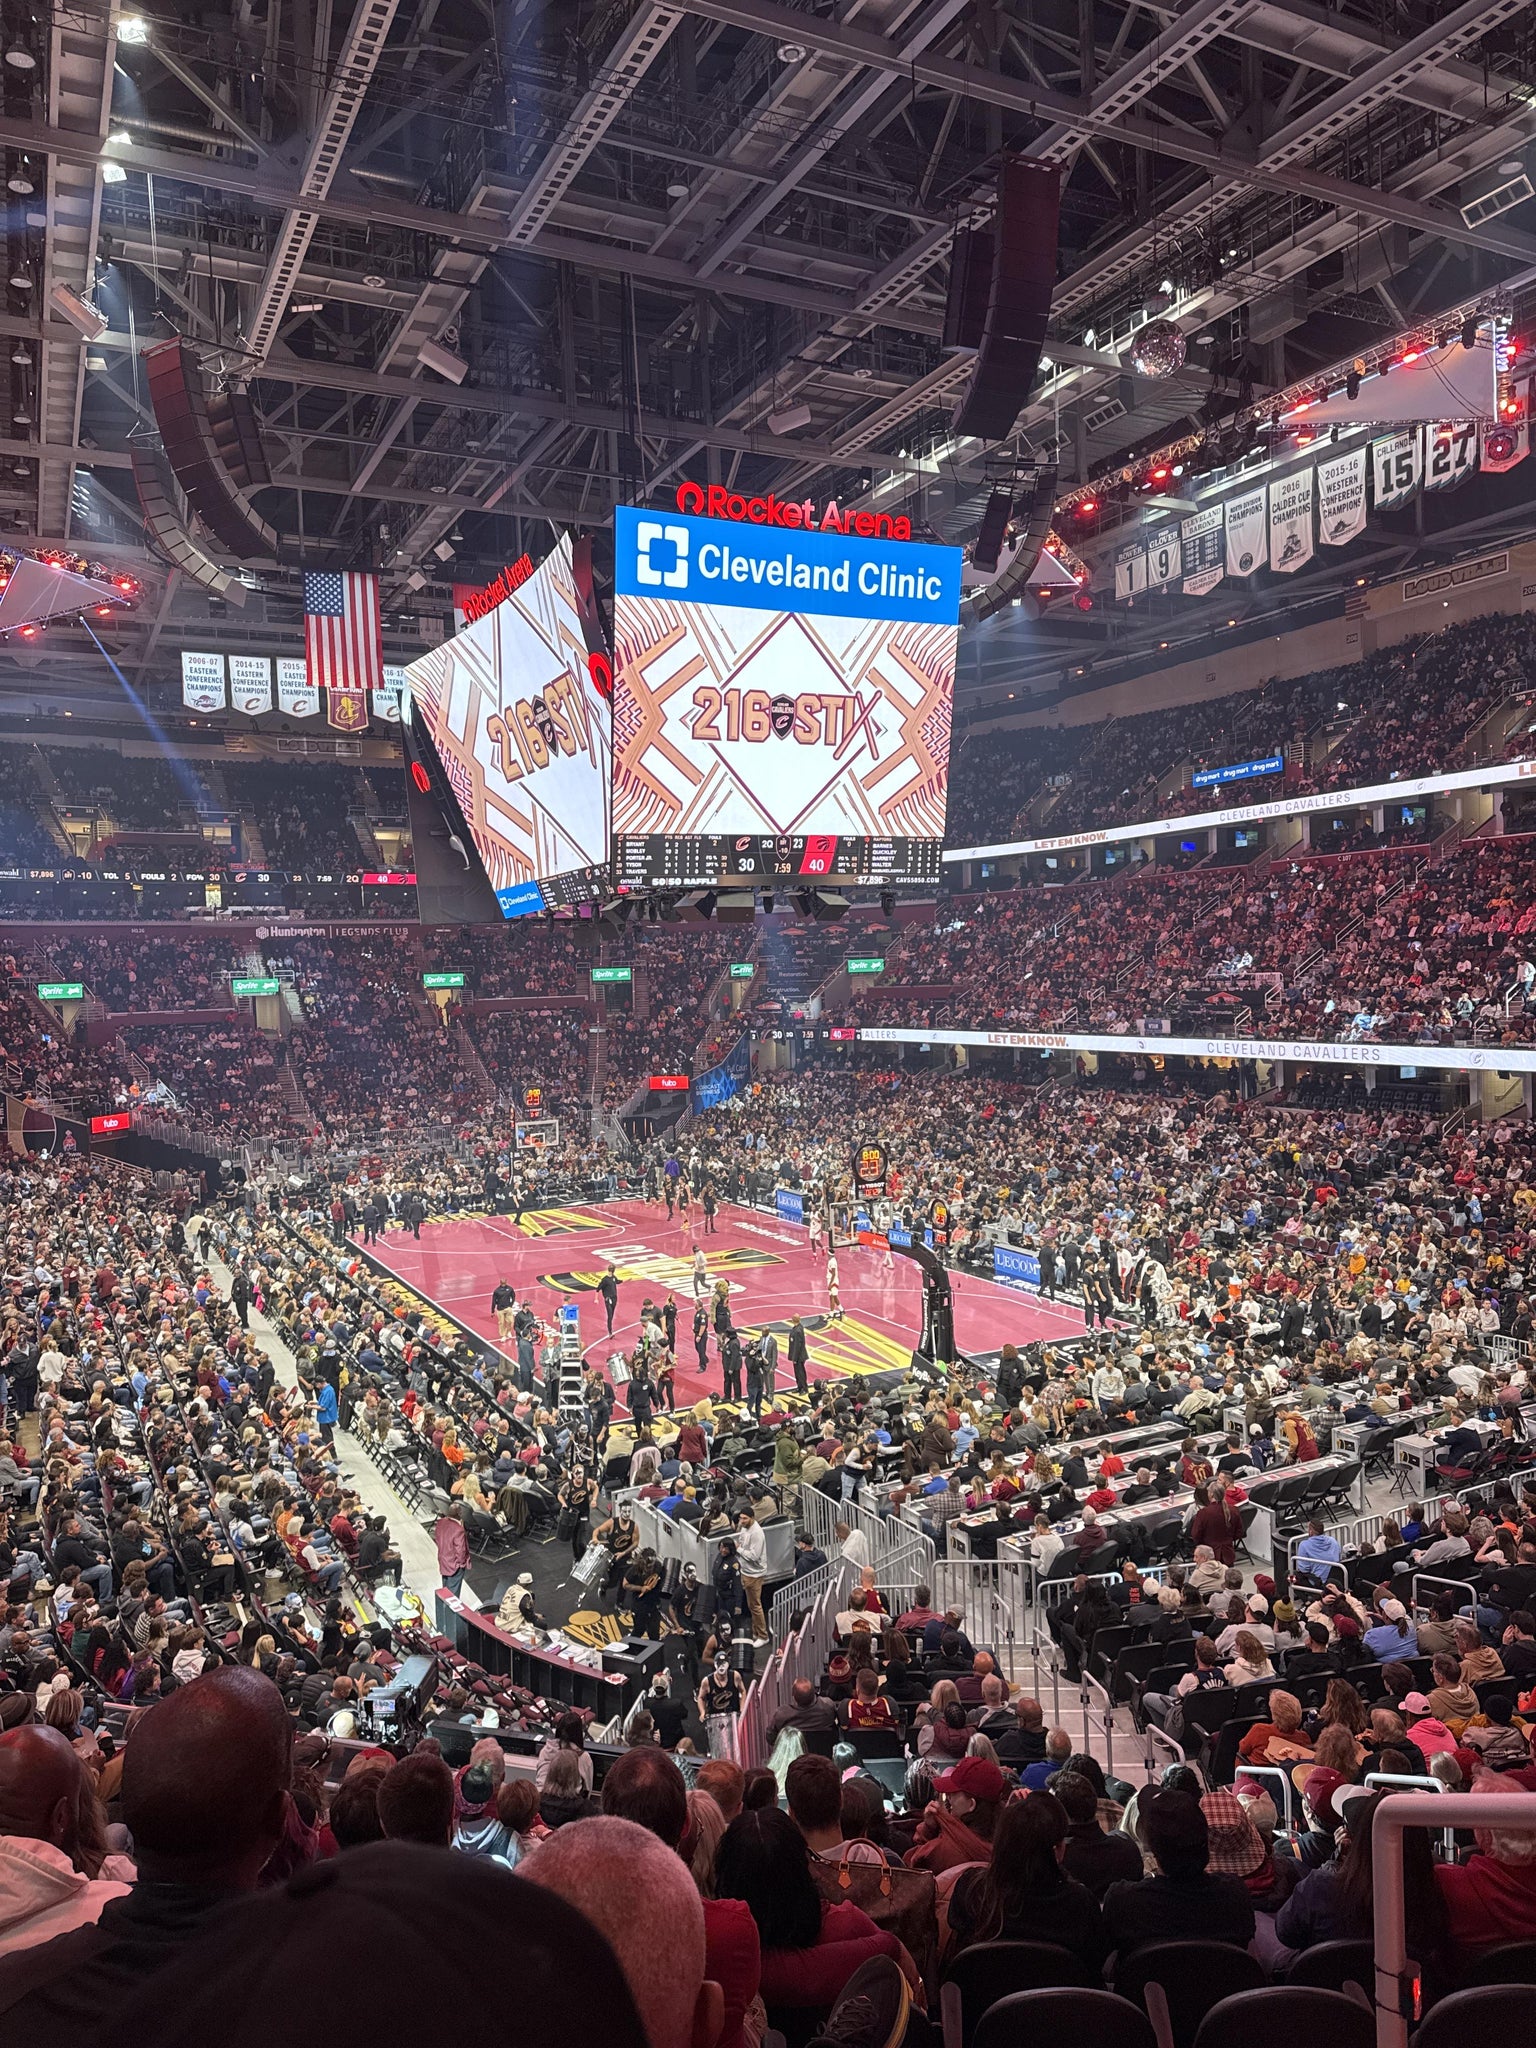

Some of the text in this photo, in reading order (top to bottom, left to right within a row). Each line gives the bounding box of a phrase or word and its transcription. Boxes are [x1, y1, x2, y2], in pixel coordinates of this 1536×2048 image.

[1433, 428, 1471, 477] 27
[1325, 461, 1359, 480] 2015-16
[1382, 450, 1414, 495] 15
[1282, 480, 1300, 495] 2016
[1326, 474, 1359, 493] WESTERN
[1272, 490, 1310, 513] CALDER CUP
[1321, 484, 1363, 507] CONFERENCE
[707, 484, 911, 540] Rocket Arena
[1228, 503, 1263, 523] CHAMPIONS
[1273, 503, 1311, 526] CHAMPIONS
[1323, 498, 1361, 519] CHAMPIONS
[1182, 508, 1222, 529] CLEVELAND
[1189, 518, 1216, 535] BARONS
[1149, 531, 1178, 549] GLOVER
[1118, 546, 1143, 561] BOWER
[1158, 549, 1169, 579] 9
[698, 543, 942, 601] Cleveland Clinic
[1127, 562, 1134, 592] 1
[473, 552, 534, 615] Rocket Arena
[188, 656, 218, 666] 2006-07
[235, 660, 264, 669] 2014-15
[283, 662, 307, 671] 2015-1
[190, 666, 217, 675] EASTERN
[237, 670, 263, 678] EASTERN
[285, 672, 307, 680] EASTER
[185, 676, 223, 684] CONFERENCE
[233, 679, 269, 687] CONFERENCE
[187, 684, 222, 692] CHAMPIONS
[234, 687, 268, 695] CHAMPIONS
[281, 688, 315, 697] CHAMPIONS
[692, 686, 882, 761] 216 STIX
[487, 697, 550, 784] 216
[1223, 766, 1249, 777] drug mart
[1252, 760, 1279, 771] drug mart
[1195, 772, 1220, 783] drug mart
[1219, 793, 1351, 822] CLEVELAND CAVALIERS
[762, 840, 773, 848] 2Q
[793, 838, 803, 849] 23
[1034, 831, 1109, 850] LET EM KNOW.
[738, 857, 755, 872] 30
[774, 862, 791, 874] 7:59
[809, 858, 825, 872] 40
[209, 873, 220, 881] 30
[258, 874, 270, 882] 30
[346, 875, 360, 883] 2Q
[377, 875, 388, 883] 40
[508, 890, 539, 906] Cleveland Clinic
[270, 926, 409, 938] Huntington LEGENDS CLUB
[849, 961, 868, 971] Sprite
[425, 974, 447, 987] Sprite
[594, 969, 614, 982] Sprite
[41, 986, 63, 997] Sprite
[235, 979, 259, 991] Sprite
[772, 1030, 783, 1039] 30
[802, 1030, 814, 1039] 7:59
[833, 1030, 842, 1039] 40
[988, 1034, 1070, 1047] LET EM KNOW.
[1207, 1042, 1381, 1061] CLEVELAND CAVALIERS
[661, 1079, 677, 1087] fubo
[103, 1119, 119, 1128] fubo
[862, 1150, 880, 1160] 8:00
[860, 1160, 879, 1178] 23
[777, 1195, 801, 1208] LECOM
[889, 1231, 911, 1246] LECOM
[911, 1421, 925, 1433] 45
